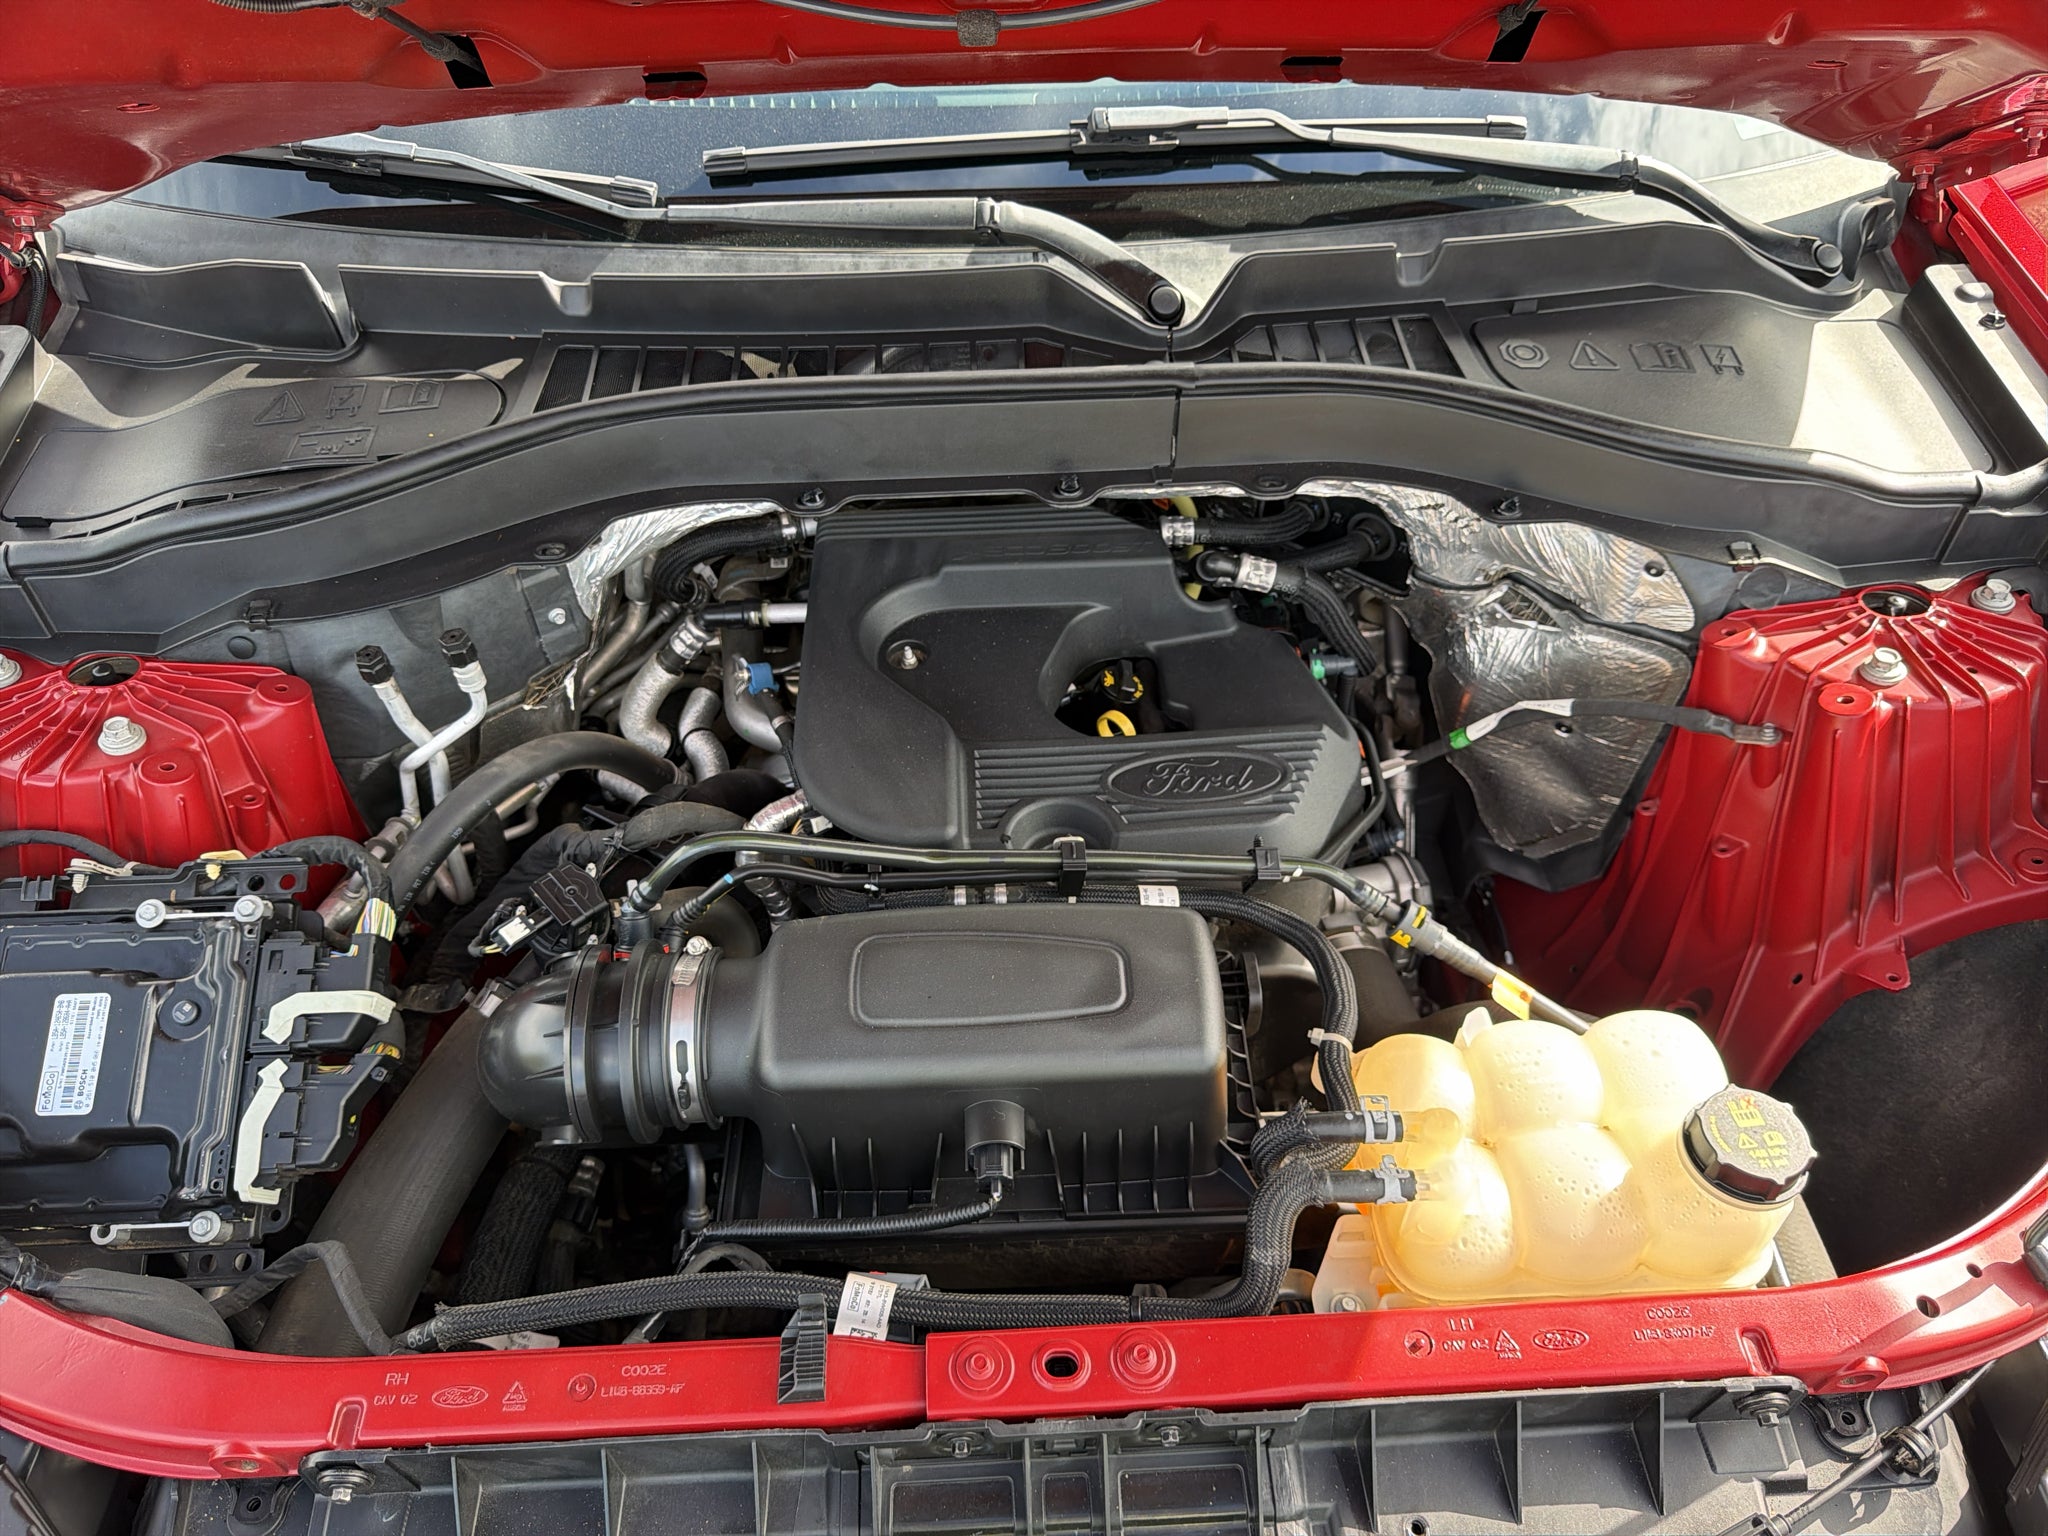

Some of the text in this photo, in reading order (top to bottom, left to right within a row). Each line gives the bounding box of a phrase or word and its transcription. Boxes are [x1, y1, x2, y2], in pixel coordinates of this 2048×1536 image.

[1143, 760, 1253, 797] Ford
[42, 1073, 56, 1110] FoMoCo
[77, 1069, 88, 1097] BOSCH
[849, 1282, 863, 1310] FoMoCo
[385, 1372, 409, 1386] RH
[373, 1393, 418, 1406] CAV 02
